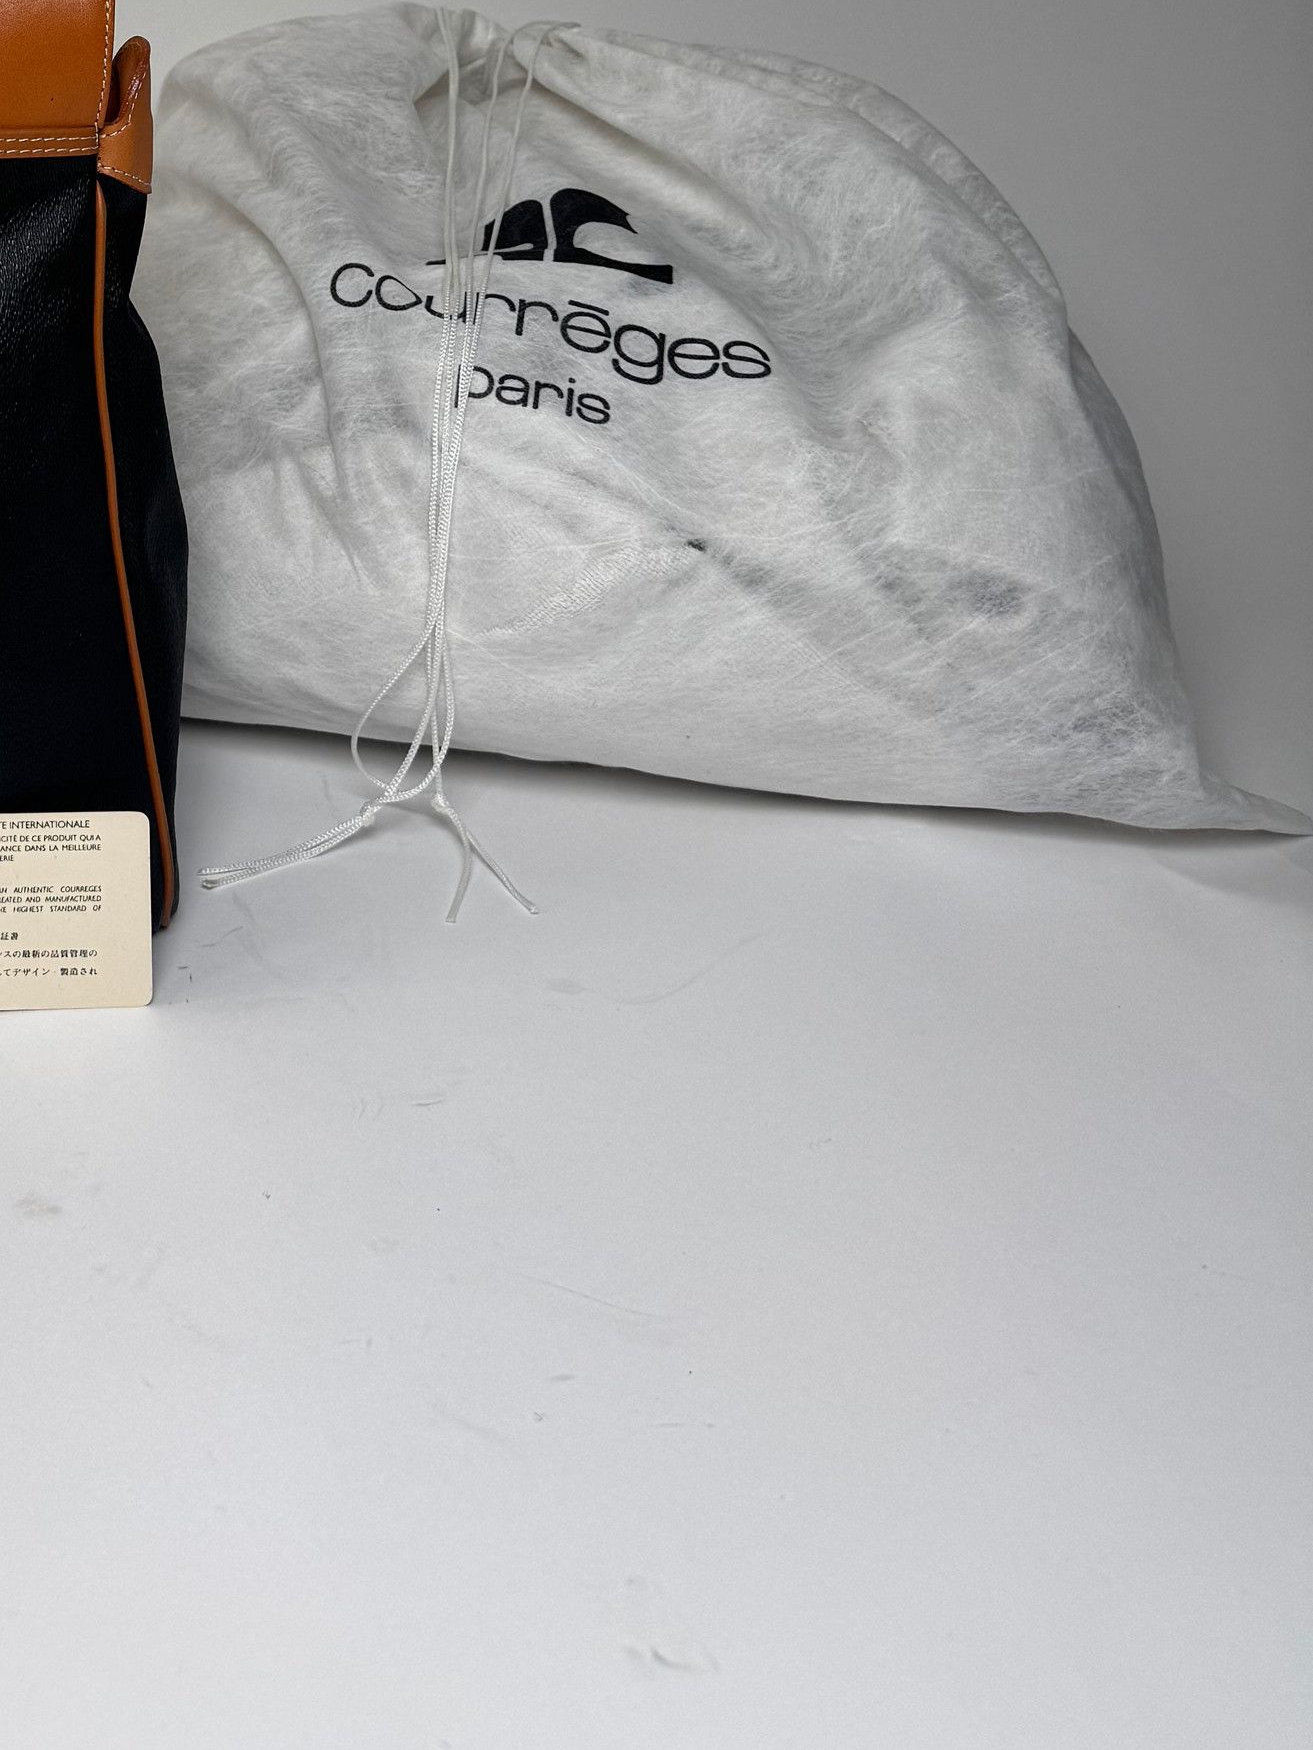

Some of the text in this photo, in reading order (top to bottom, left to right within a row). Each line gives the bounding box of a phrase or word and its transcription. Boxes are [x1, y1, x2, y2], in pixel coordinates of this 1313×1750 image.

[455, 364, 611, 425] paris
[9, 820, 90, 829] INTERNATIONALE
[44, 834, 77, 842] PRODUIT
[79, 834, 94, 842] QUI
[24, 844, 46, 852] DANS
[62, 843, 101, 852] MEILLEURE
[13, 905, 44, 913] HIGHEST
[92, 904, 102, 912] OF
